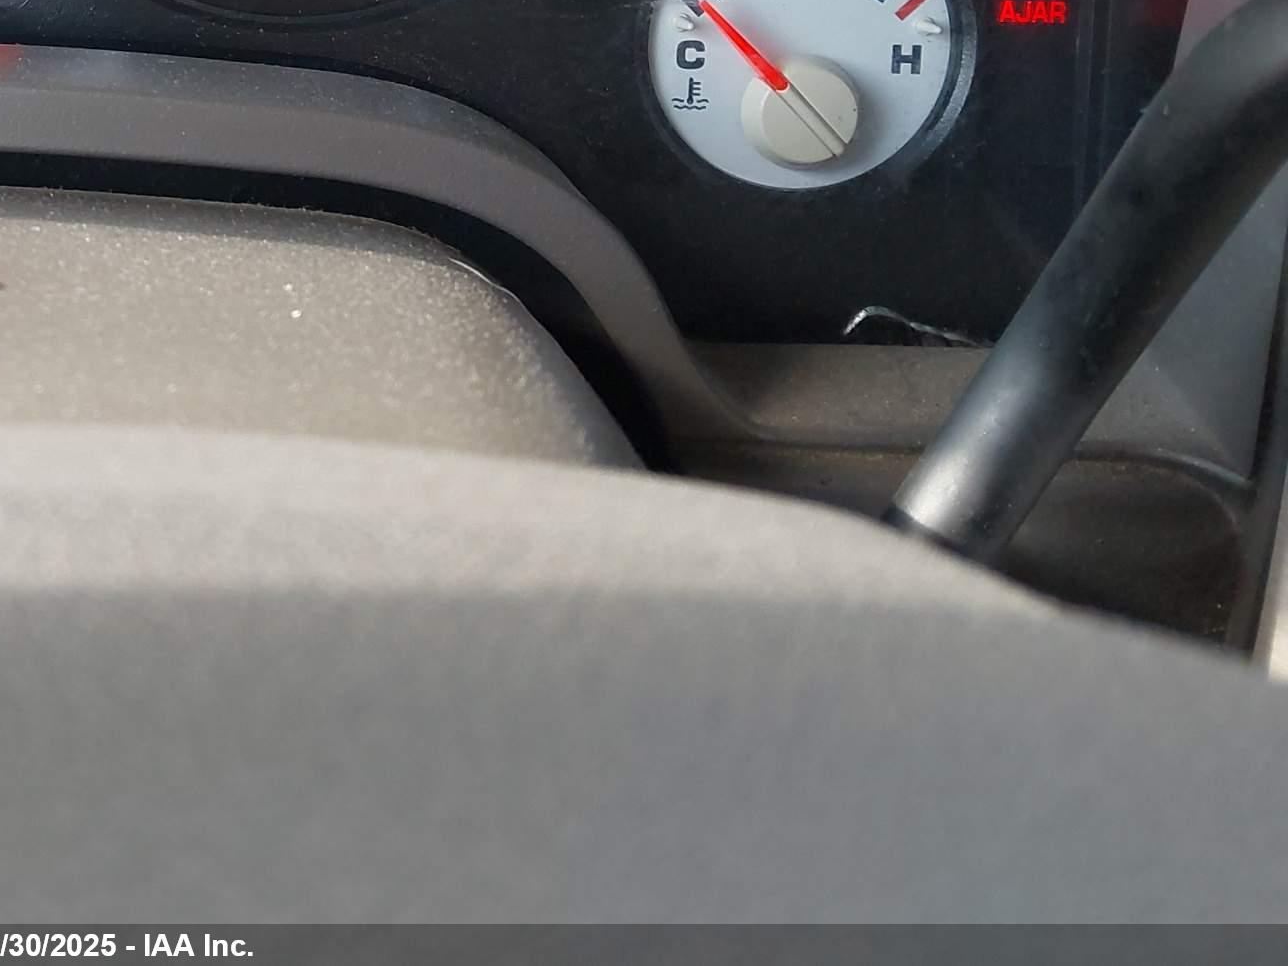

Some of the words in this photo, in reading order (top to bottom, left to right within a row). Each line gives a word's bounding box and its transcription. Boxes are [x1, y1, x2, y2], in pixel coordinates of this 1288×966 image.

[999, 1, 1065, 23] AJAR
[677, 41, 705, 69] C
[892, 45, 921, 74] H
